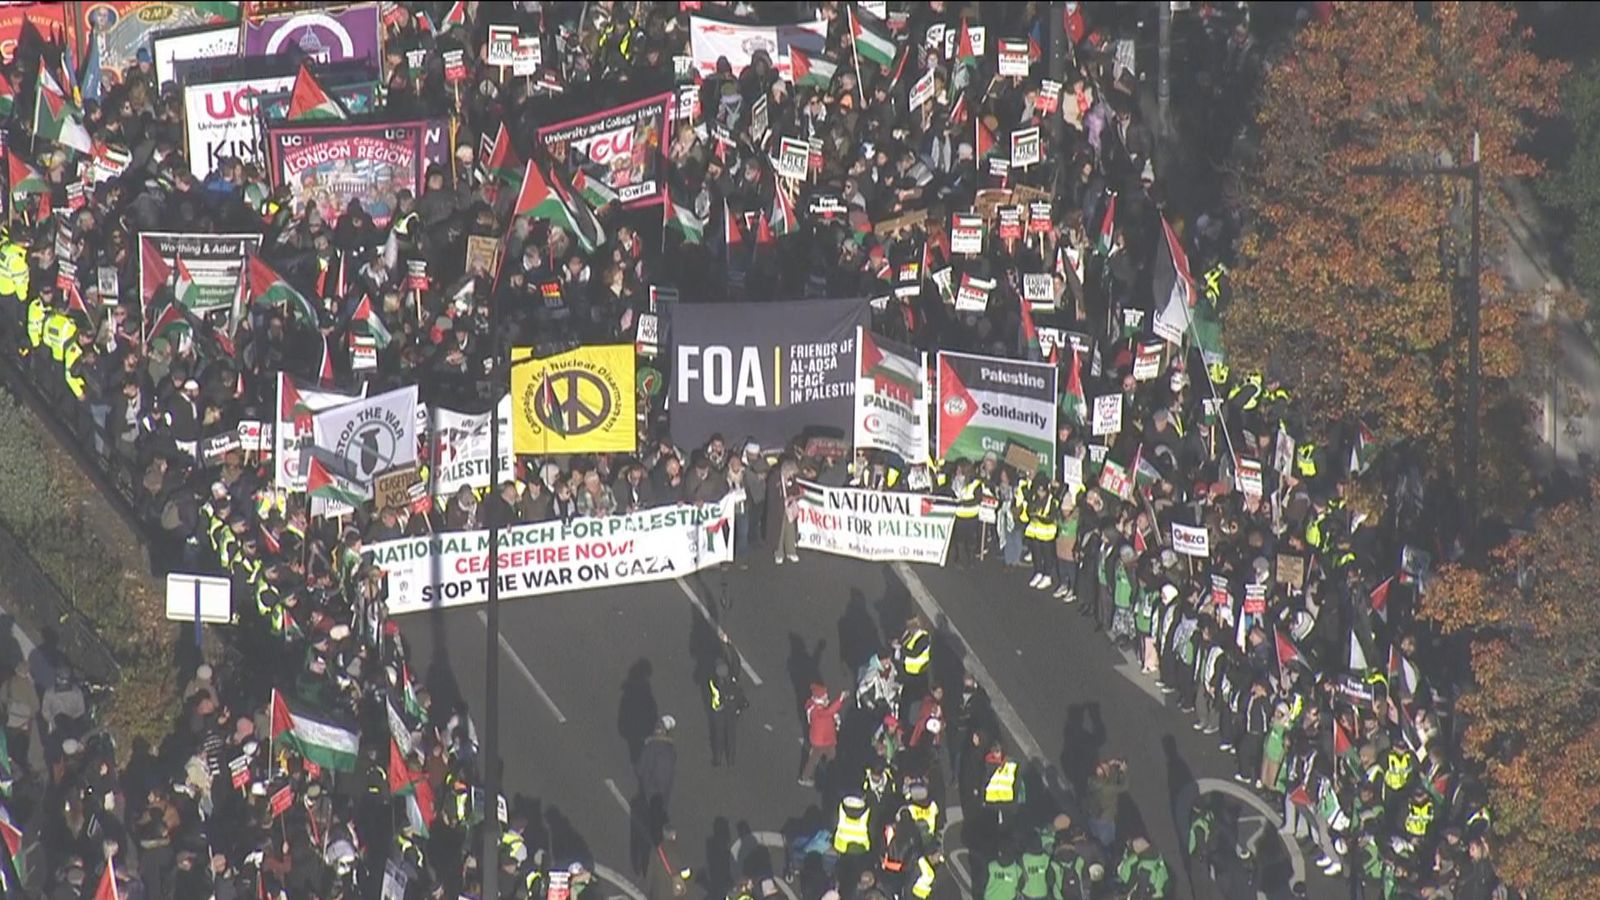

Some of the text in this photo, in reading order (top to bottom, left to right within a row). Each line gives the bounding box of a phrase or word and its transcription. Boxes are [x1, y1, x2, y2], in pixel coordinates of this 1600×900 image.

[544, 126, 589, 144] University
[589, 120, 605, 134] and
[606, 112, 637, 129] College
[638, 105, 662, 119] Union
[285, 141, 329, 162] University
[334, 137, 348, 147] and
[287, 145, 410, 174] LONDON REGION
[160, 243, 237, 256] Wothing & Adur
[790, 338, 854, 358] FRIENDS OF
[678, 345, 767, 407] FOA
[790, 371, 825, 389] PEACE
[980, 367, 1046, 390] Palestine
[549, 359, 597, 371] Nuclear
[597, 367, 622, 433] Disarmament
[790, 381, 855, 405] IN PALESTIN
[981, 402, 1047, 430] Solidarity
[335, 420, 355, 459] STOP
[356, 406, 383, 422] THE
[385, 409, 405, 441] WAR
[435, 455, 510, 482] PALESTIE
[828, 490, 915, 517] NATIONAL
[371, 506, 722, 565] NATIONAL MARCH FOR PALESTINE
[847, 517, 872, 537] FOR
[878, 519, 948, 541] PALESTIN
[454, 539, 635, 575] CEASEFIRE NOW!
[421, 579, 473, 602] STOP
[522, 566, 573, 589] WAR
[577, 562, 609, 582] ON
[615, 554, 675, 578] GAZA
